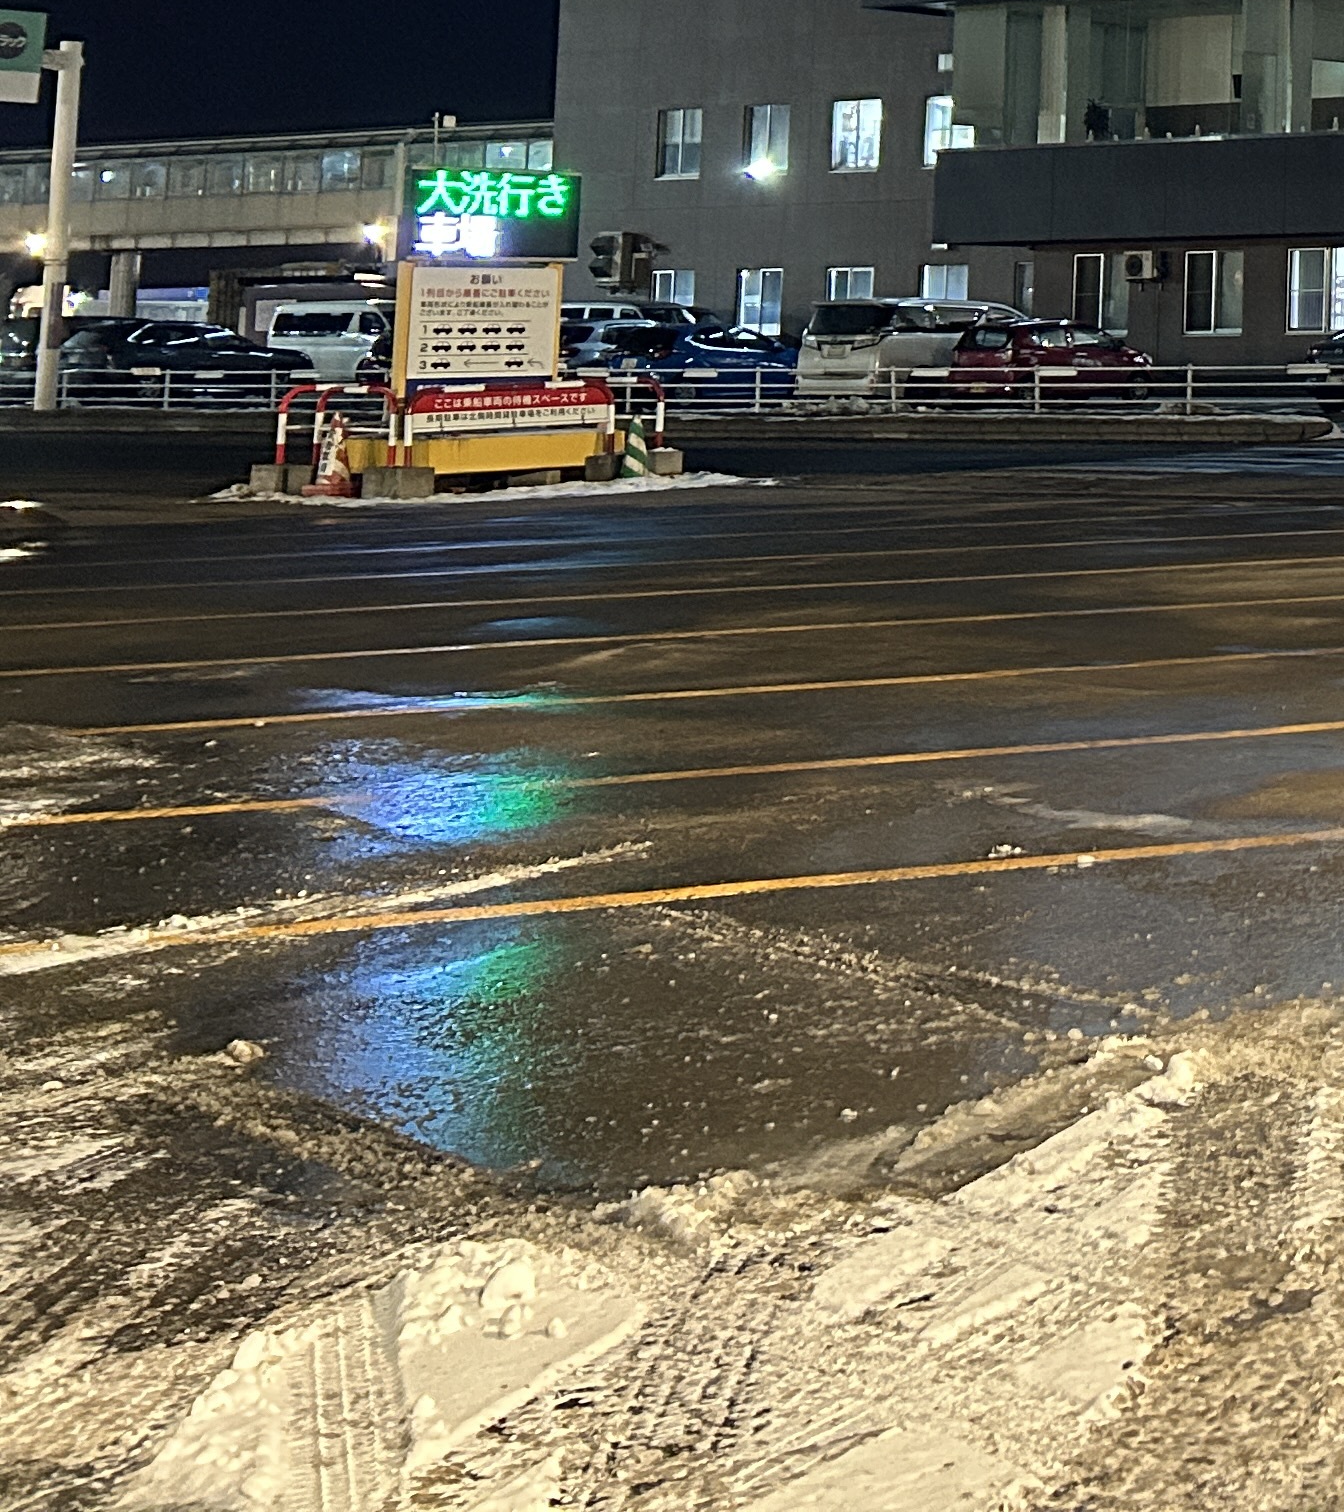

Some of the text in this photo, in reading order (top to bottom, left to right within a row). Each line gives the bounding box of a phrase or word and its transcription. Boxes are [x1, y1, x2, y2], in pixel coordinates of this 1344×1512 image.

[415, 169, 570, 217] 大洗行き
[470, 274, 502, 285] お願い
[422, 324, 428, 334] 1
[419, 343, 428, 352] 2
[418, 360, 427, 369] 3
